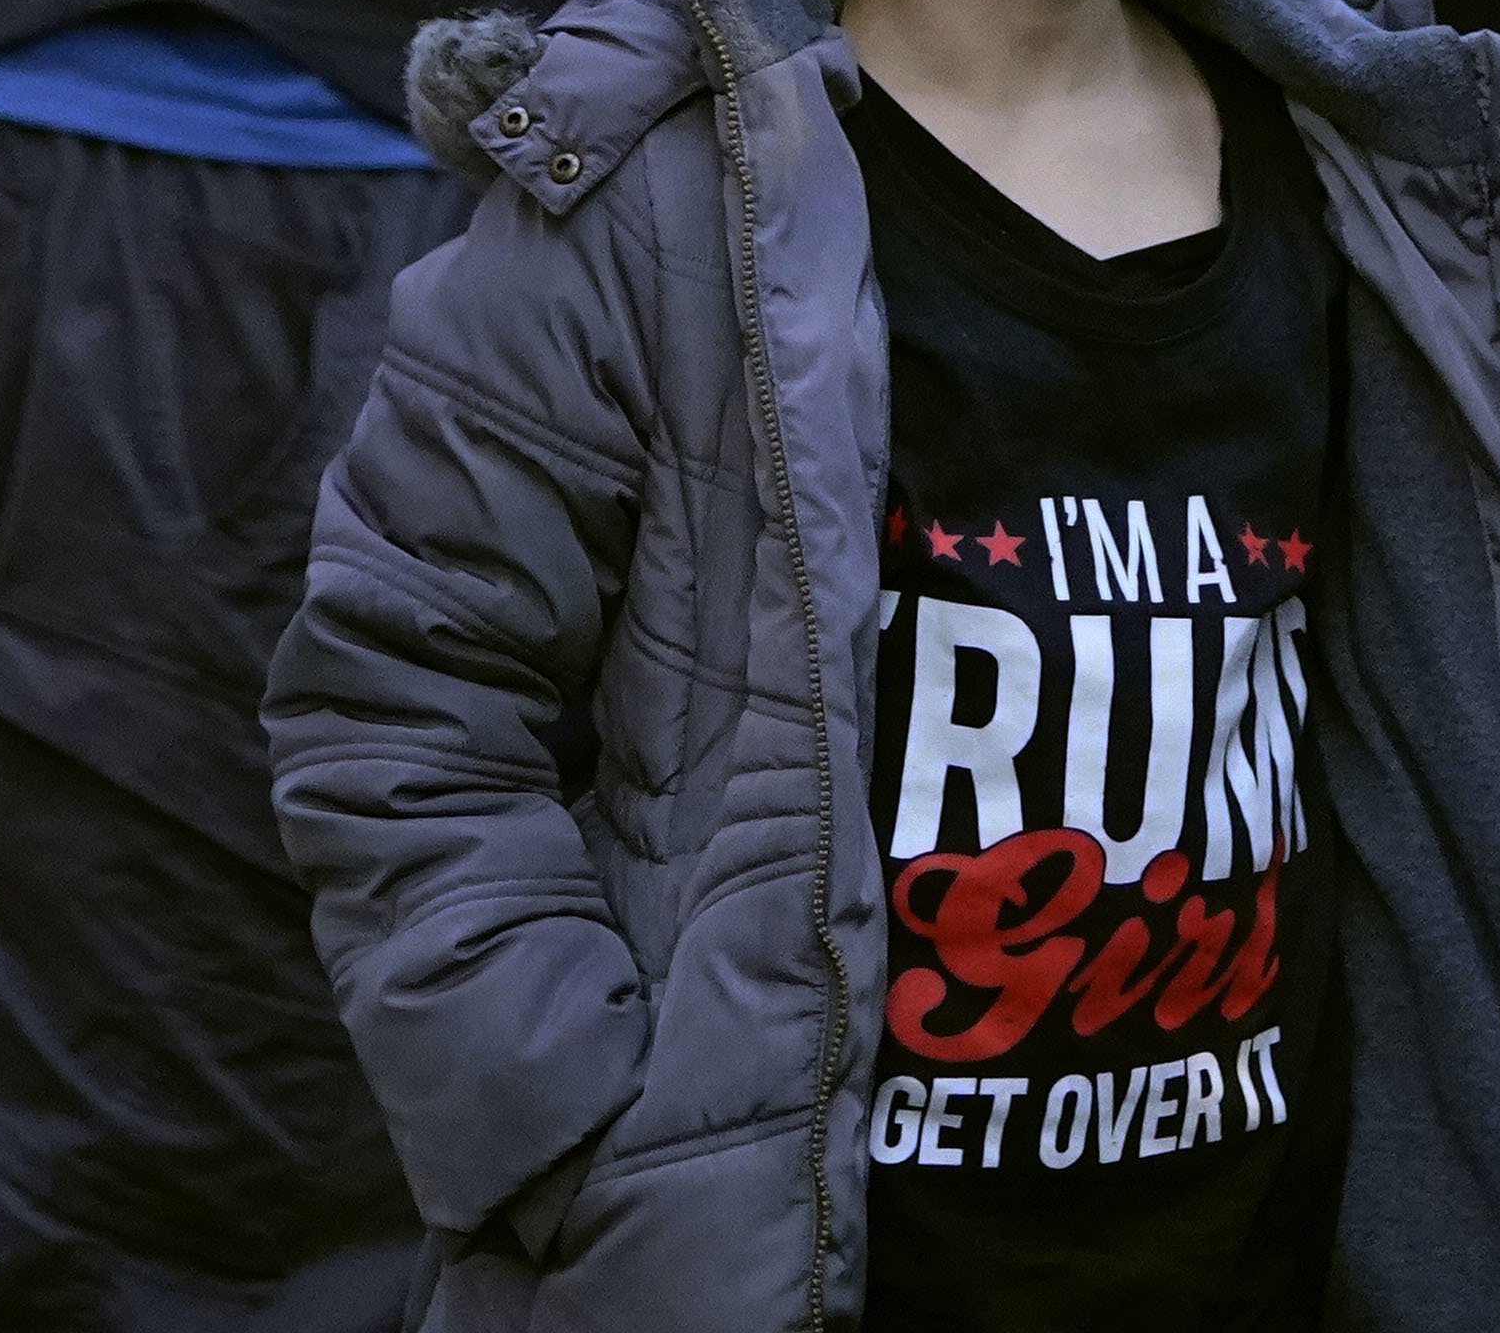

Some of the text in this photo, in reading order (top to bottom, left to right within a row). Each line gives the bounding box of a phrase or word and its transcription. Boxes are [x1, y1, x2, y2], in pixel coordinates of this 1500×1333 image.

[1039, 494, 1237, 604] I'M A
[884, 827, 1285, 1064] Girl
[870, 1025, 1290, 1171] GET OVER IT
